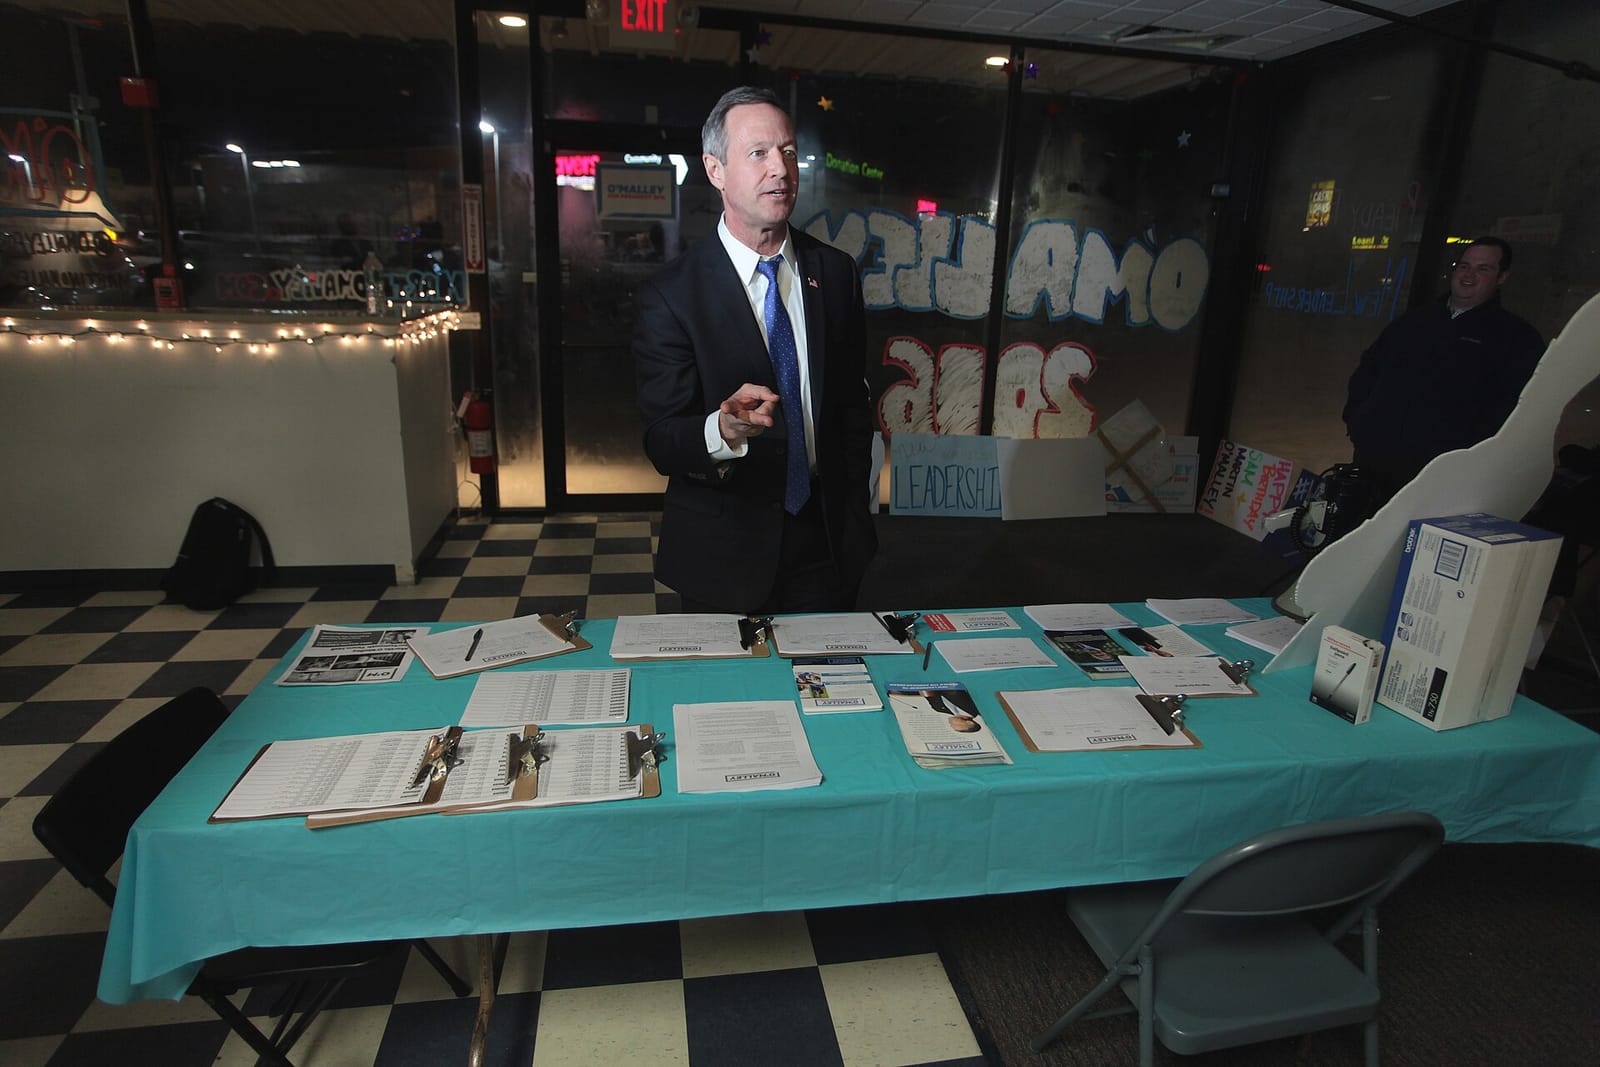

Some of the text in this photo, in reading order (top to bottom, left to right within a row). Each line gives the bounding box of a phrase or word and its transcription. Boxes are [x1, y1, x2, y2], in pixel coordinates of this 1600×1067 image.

[621, 0, 668, 32] EXIT
[826, 152, 884, 180] Donation Center
[607, 184, 665, 194] O'MALLEY
[1222, 447, 1248, 499] MARTIN
[1242, 464, 1278, 531] BIRTHDAY
[1262, 460, 1291, 518] HAPPY
[1404, 527, 1416, 554] brother
[365, 671, 391, 679] O'M
[933, 743, 975, 751] O'MALLEY
[1092, 735, 1132, 743] O'MALLEY
[729, 771, 777, 781] O'MALLEY
